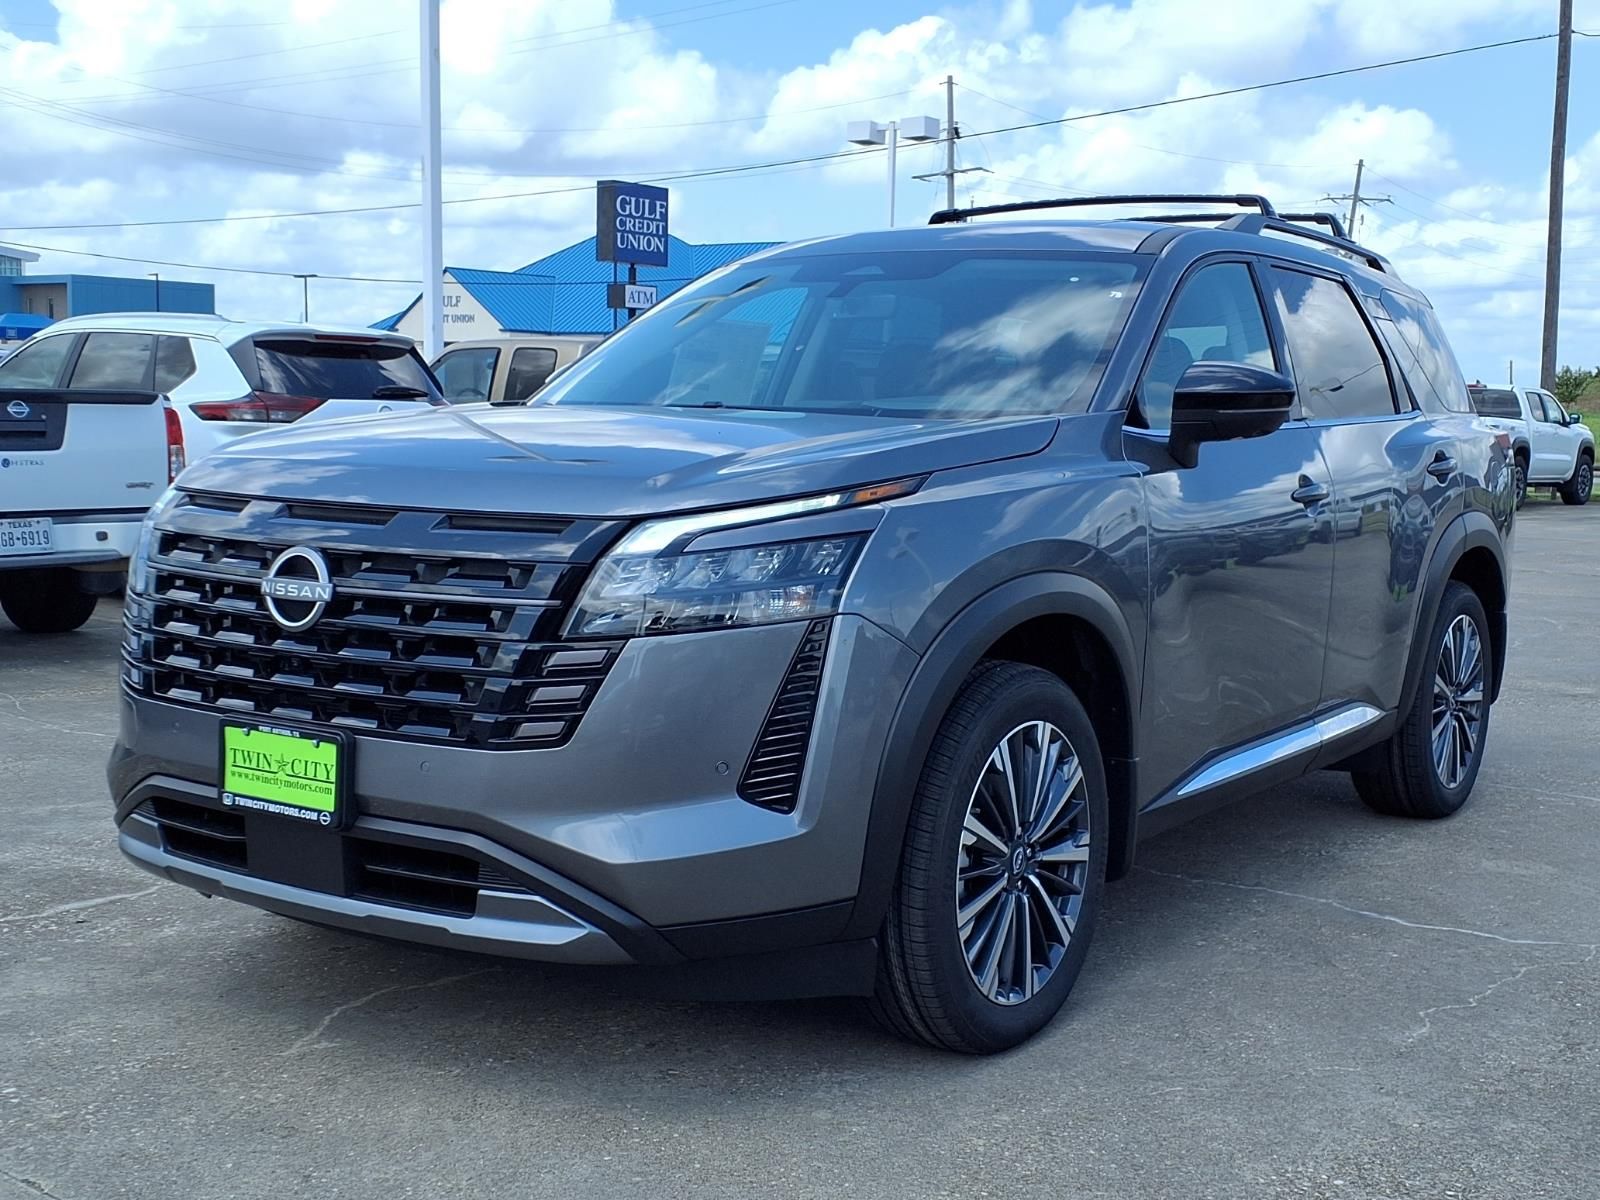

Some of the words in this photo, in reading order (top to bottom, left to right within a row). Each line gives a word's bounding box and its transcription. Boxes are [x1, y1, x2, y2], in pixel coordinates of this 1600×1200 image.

[616, 195, 666, 219] GULF
[616, 216, 665, 235] CREDIT
[616, 232, 665, 253] UNION
[442, 295, 461, 307] ULF
[628, 291, 653, 305] ATM
[451, 314, 475, 323] UNION
[261, 581, 329, 599] NISSAN
[229, 748, 273, 770] TWIN
[290, 758, 335, 780] CITY
[230, 770, 333, 795] www.twincitymotors.com
[234, 797, 318, 821] TWINCITYMOTORS.COM
